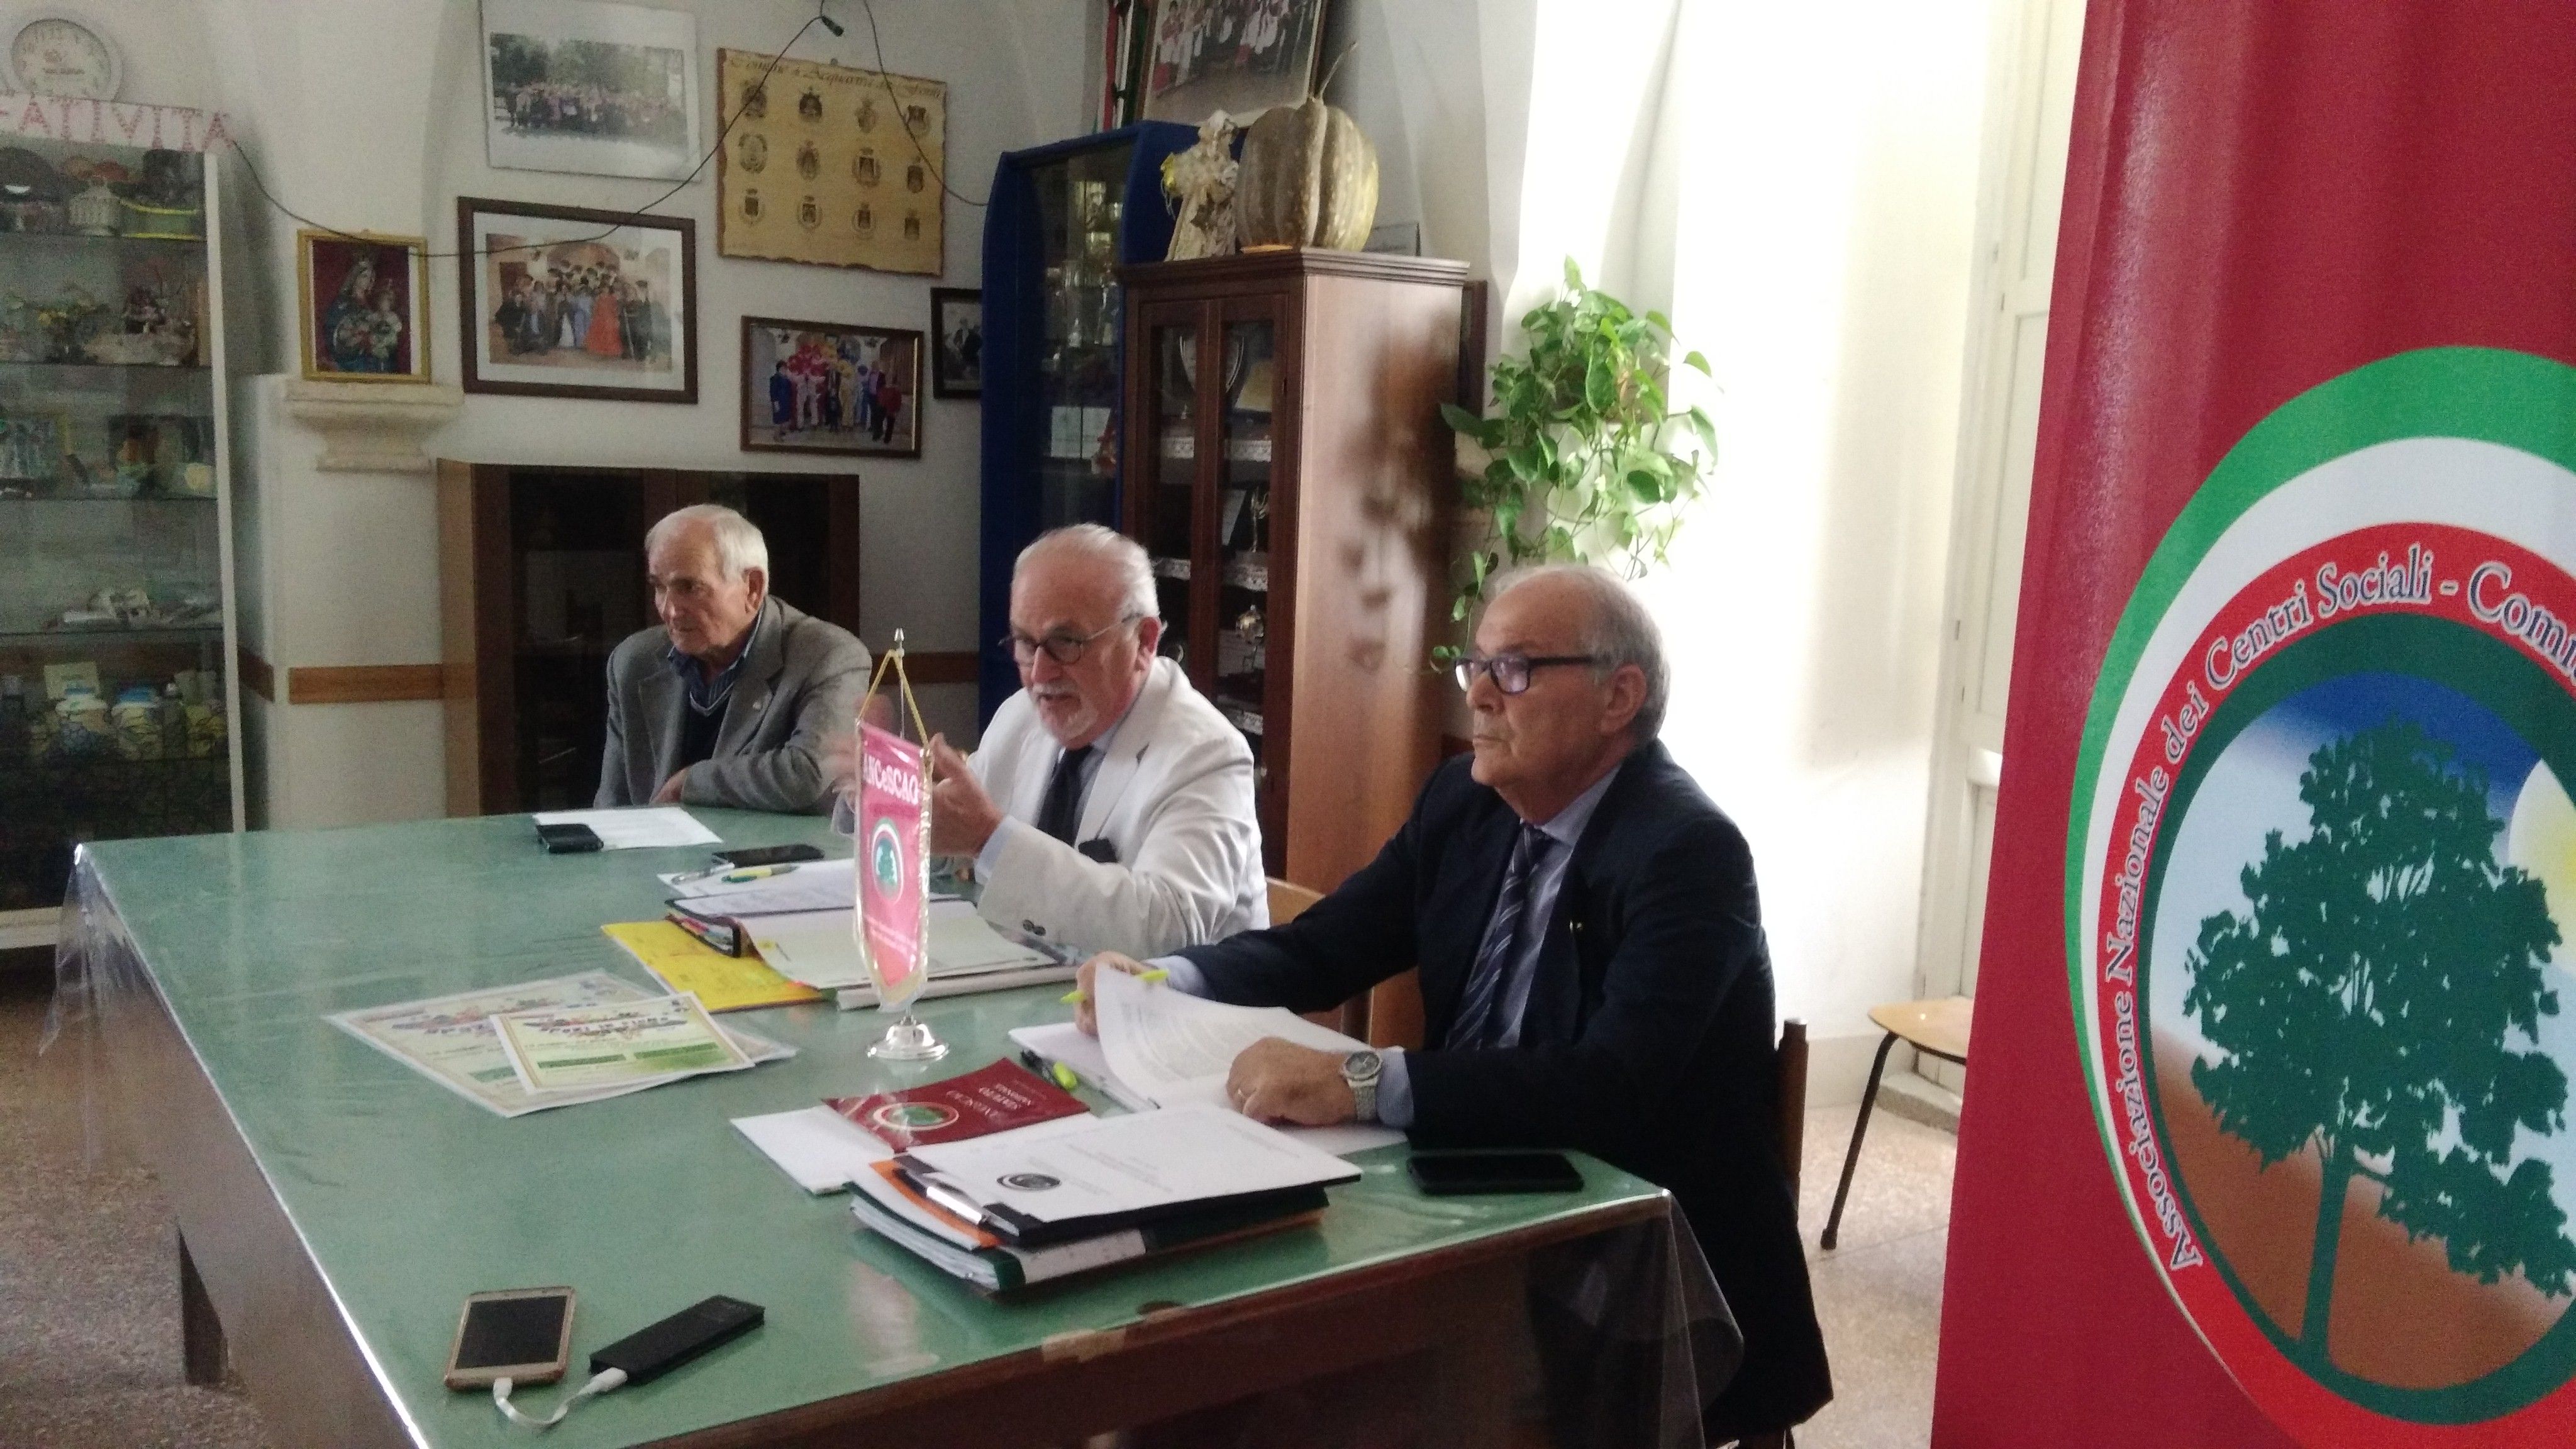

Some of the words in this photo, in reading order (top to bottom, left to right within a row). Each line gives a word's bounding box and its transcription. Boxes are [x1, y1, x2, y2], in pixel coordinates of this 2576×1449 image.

[2205, 580, 2314, 691] Centri
[2316, 543, 2433, 618] Sociali
[2162, 681, 2208, 765] dei
[2105, 766, 2169, 987] Nazionale
[2114, 991, 2202, 1270] Associazione
